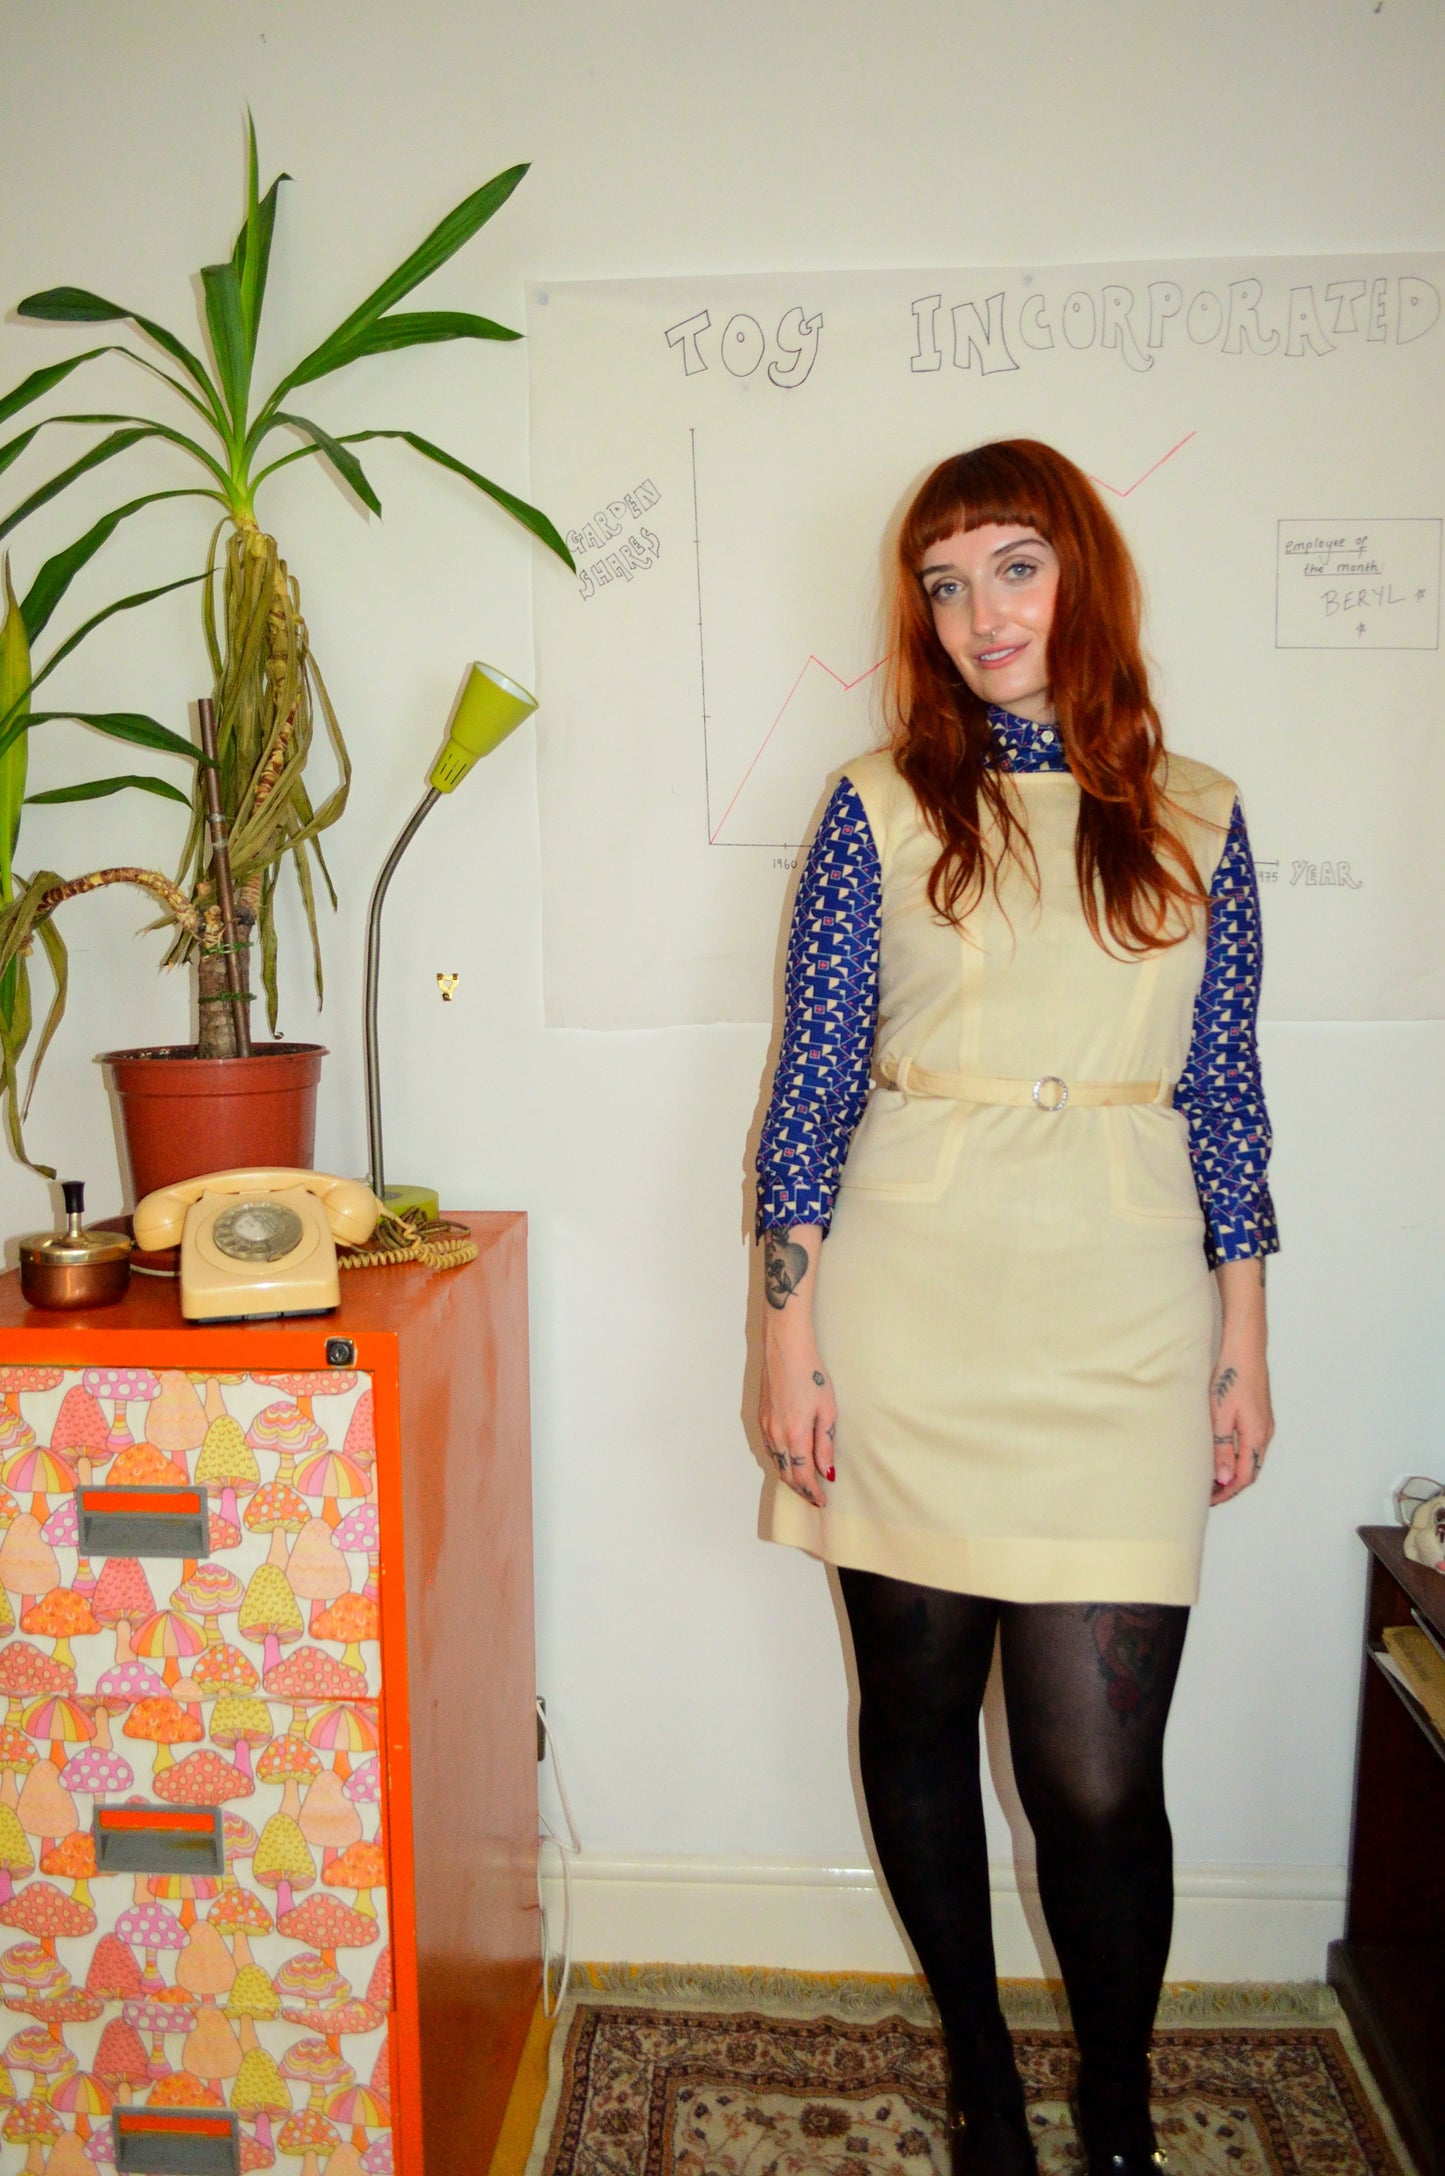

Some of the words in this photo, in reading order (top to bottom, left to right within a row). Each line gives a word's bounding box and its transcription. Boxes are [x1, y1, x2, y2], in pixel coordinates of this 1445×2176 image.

[910, 277, 1441, 376] INCORPORATED
[565, 478, 662, 555] GARDEN
[579, 527, 661, 602] SHARES
[1284, 537, 1345, 566] employee
[1355, 535, 1368, 559] of
[1303, 562, 1325, 575] the
[1320, 584, 1405, 617] BERYL
[772, 858, 798, 870] 1960
[1256, 871, 1279, 883] 975
[1289, 859, 1363, 890] YEAR
